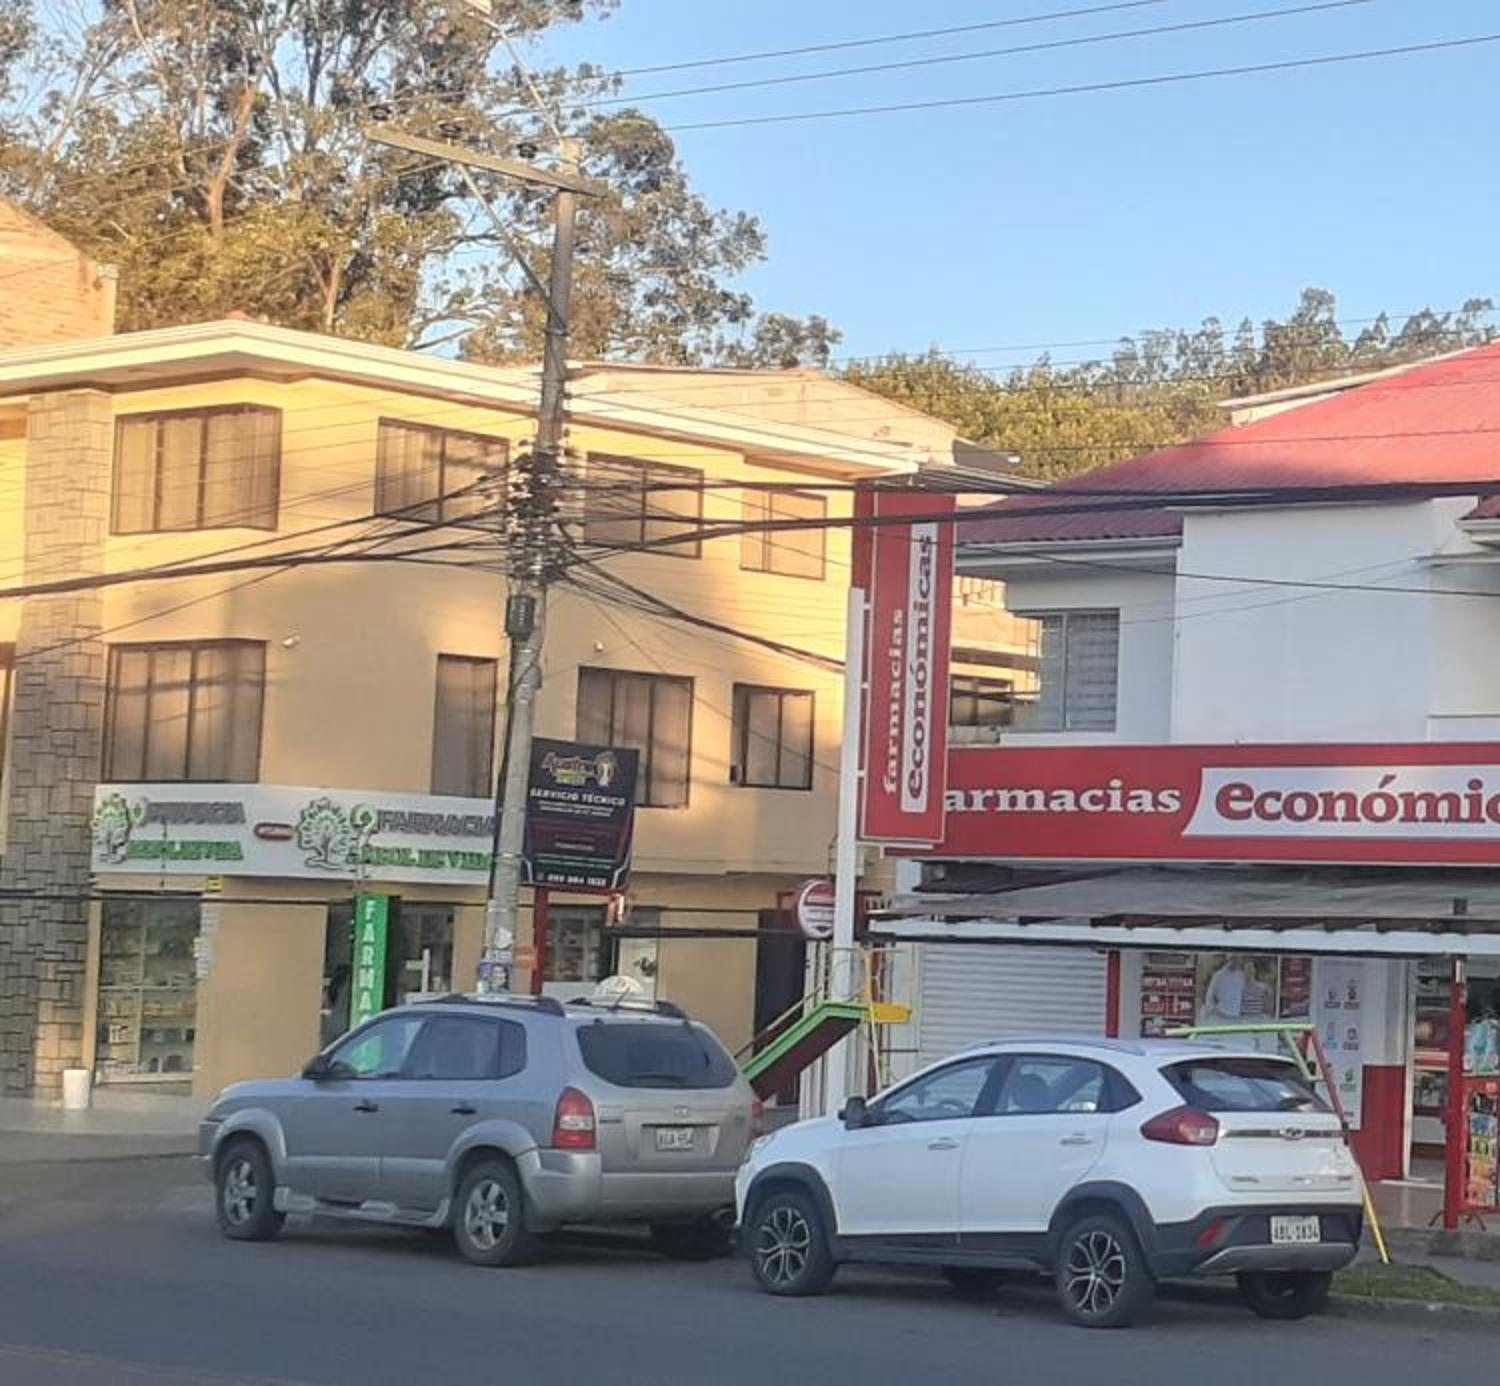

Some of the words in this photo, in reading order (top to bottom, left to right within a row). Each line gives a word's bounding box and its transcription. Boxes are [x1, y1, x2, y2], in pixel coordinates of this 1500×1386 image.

[883, 608, 903, 796] farmacias
[908, 535, 932, 800] económicas
[529, 787, 579, 801] SERVICIO
[945, 778, 1181, 813] armacias
